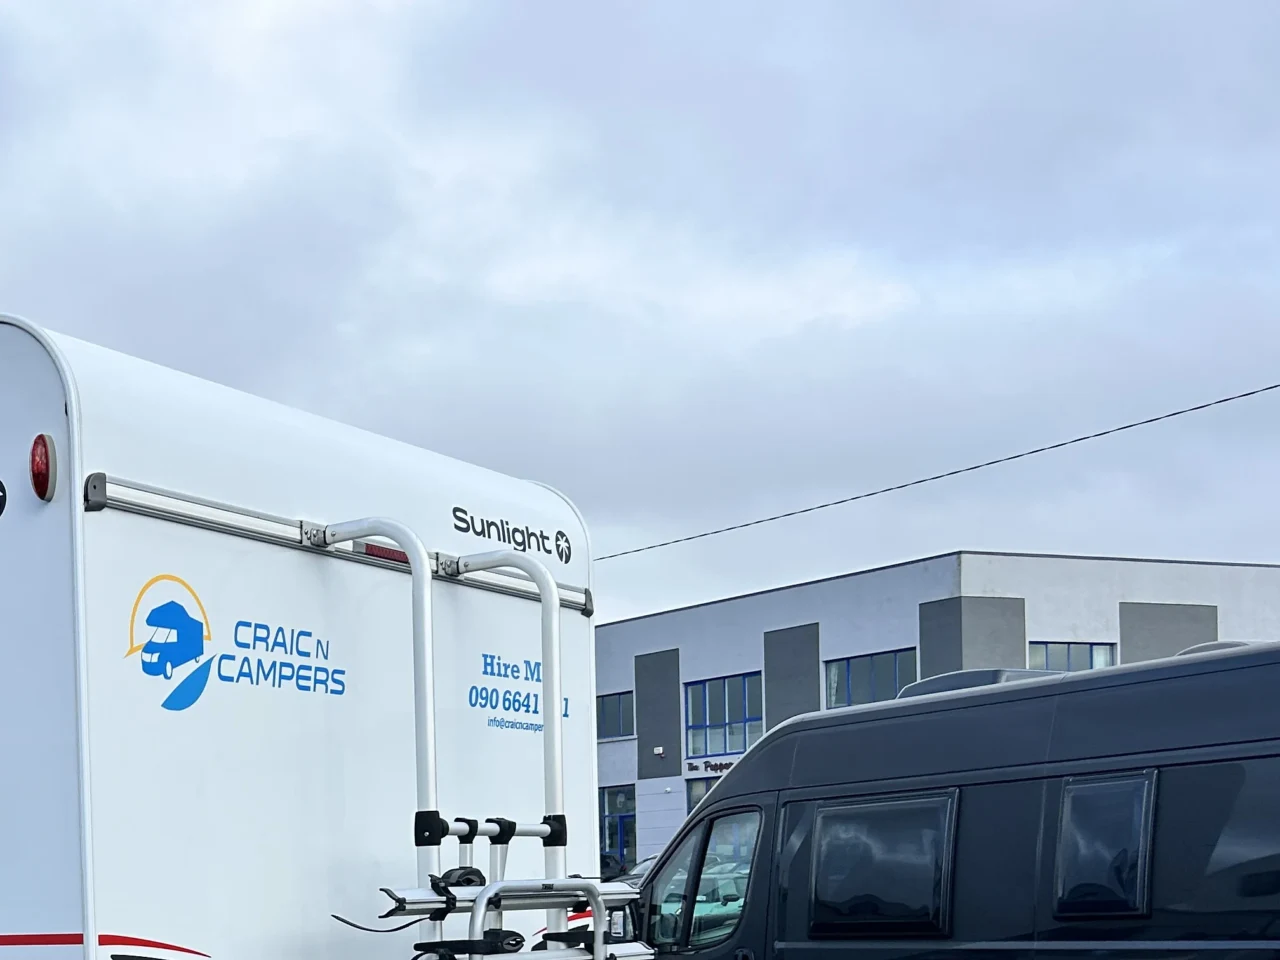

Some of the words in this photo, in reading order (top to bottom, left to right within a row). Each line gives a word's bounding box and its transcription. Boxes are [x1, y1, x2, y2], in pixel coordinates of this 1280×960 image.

[452, 506, 552, 555] Sunlight
[233, 620, 313, 658] CRAIC
[315, 639, 330, 661] N
[217, 654, 346, 696] CAMPERS
[481, 653, 521, 680] Hire
[524, 659, 542, 683] M
[468, 685, 499, 710] 090
[502, 690, 570, 718] 66411
[487, 716, 545, 733] info@craicncamper
